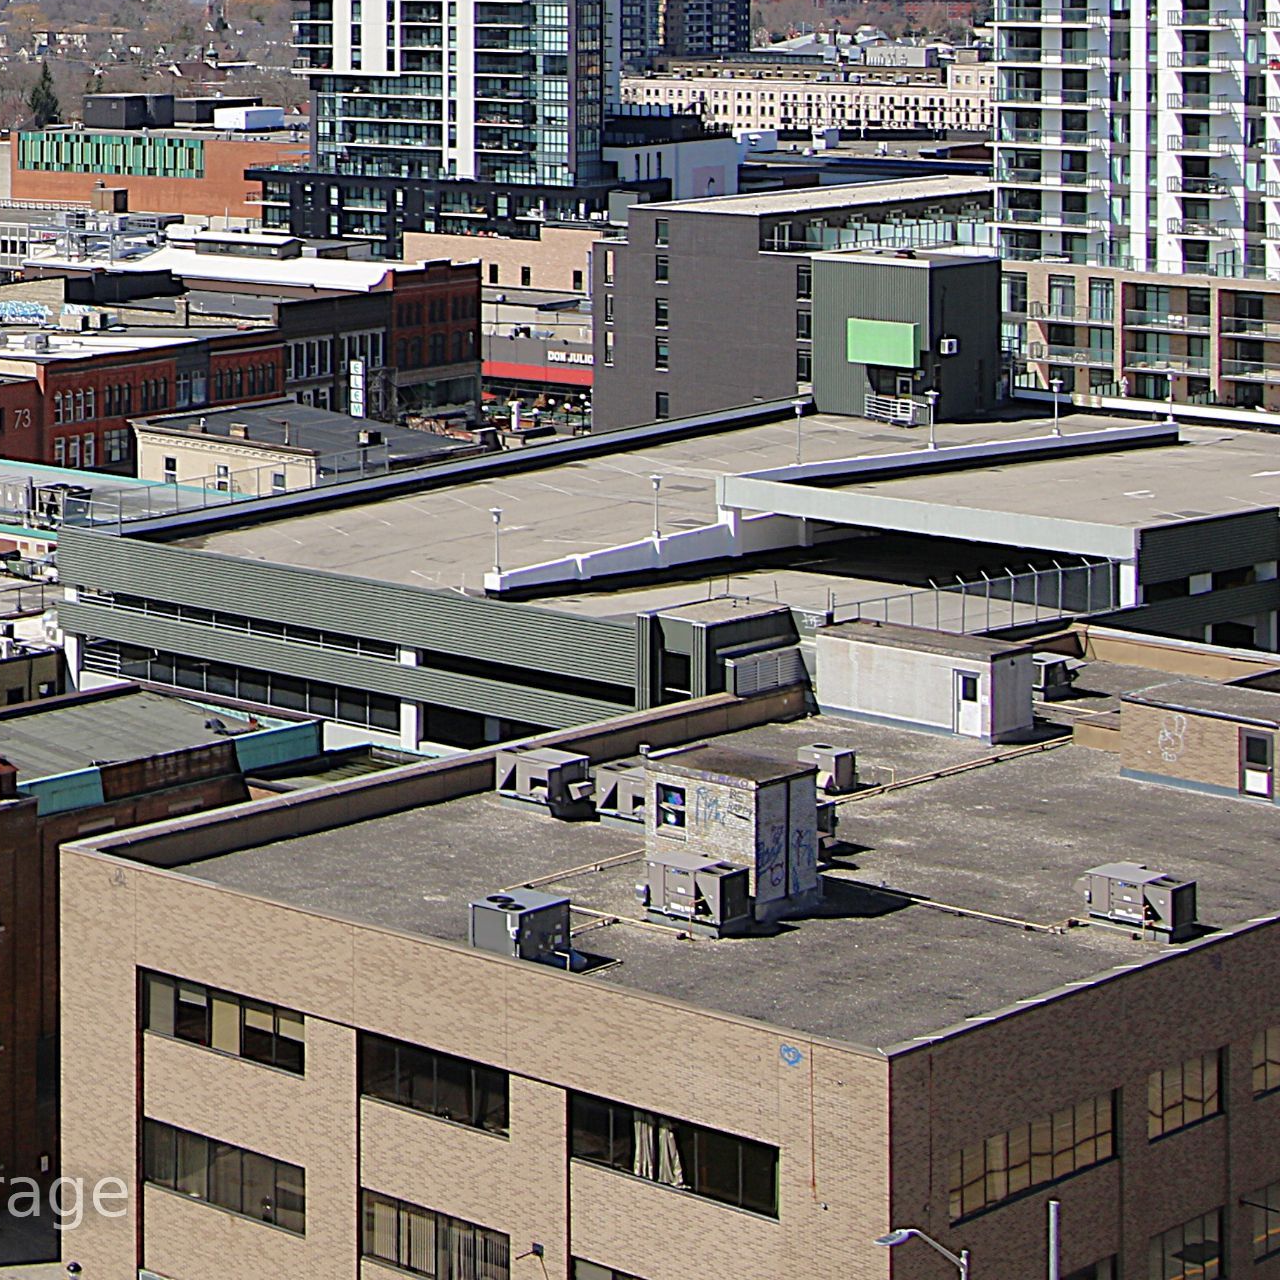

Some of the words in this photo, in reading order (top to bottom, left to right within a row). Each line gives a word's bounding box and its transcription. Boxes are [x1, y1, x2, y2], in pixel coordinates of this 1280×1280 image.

[792, 117, 848, 127] HARNESS
[928, 123, 989, 132] LEATHER
[547, 350, 567, 362] DON
[14, 408, 32, 429] 73
